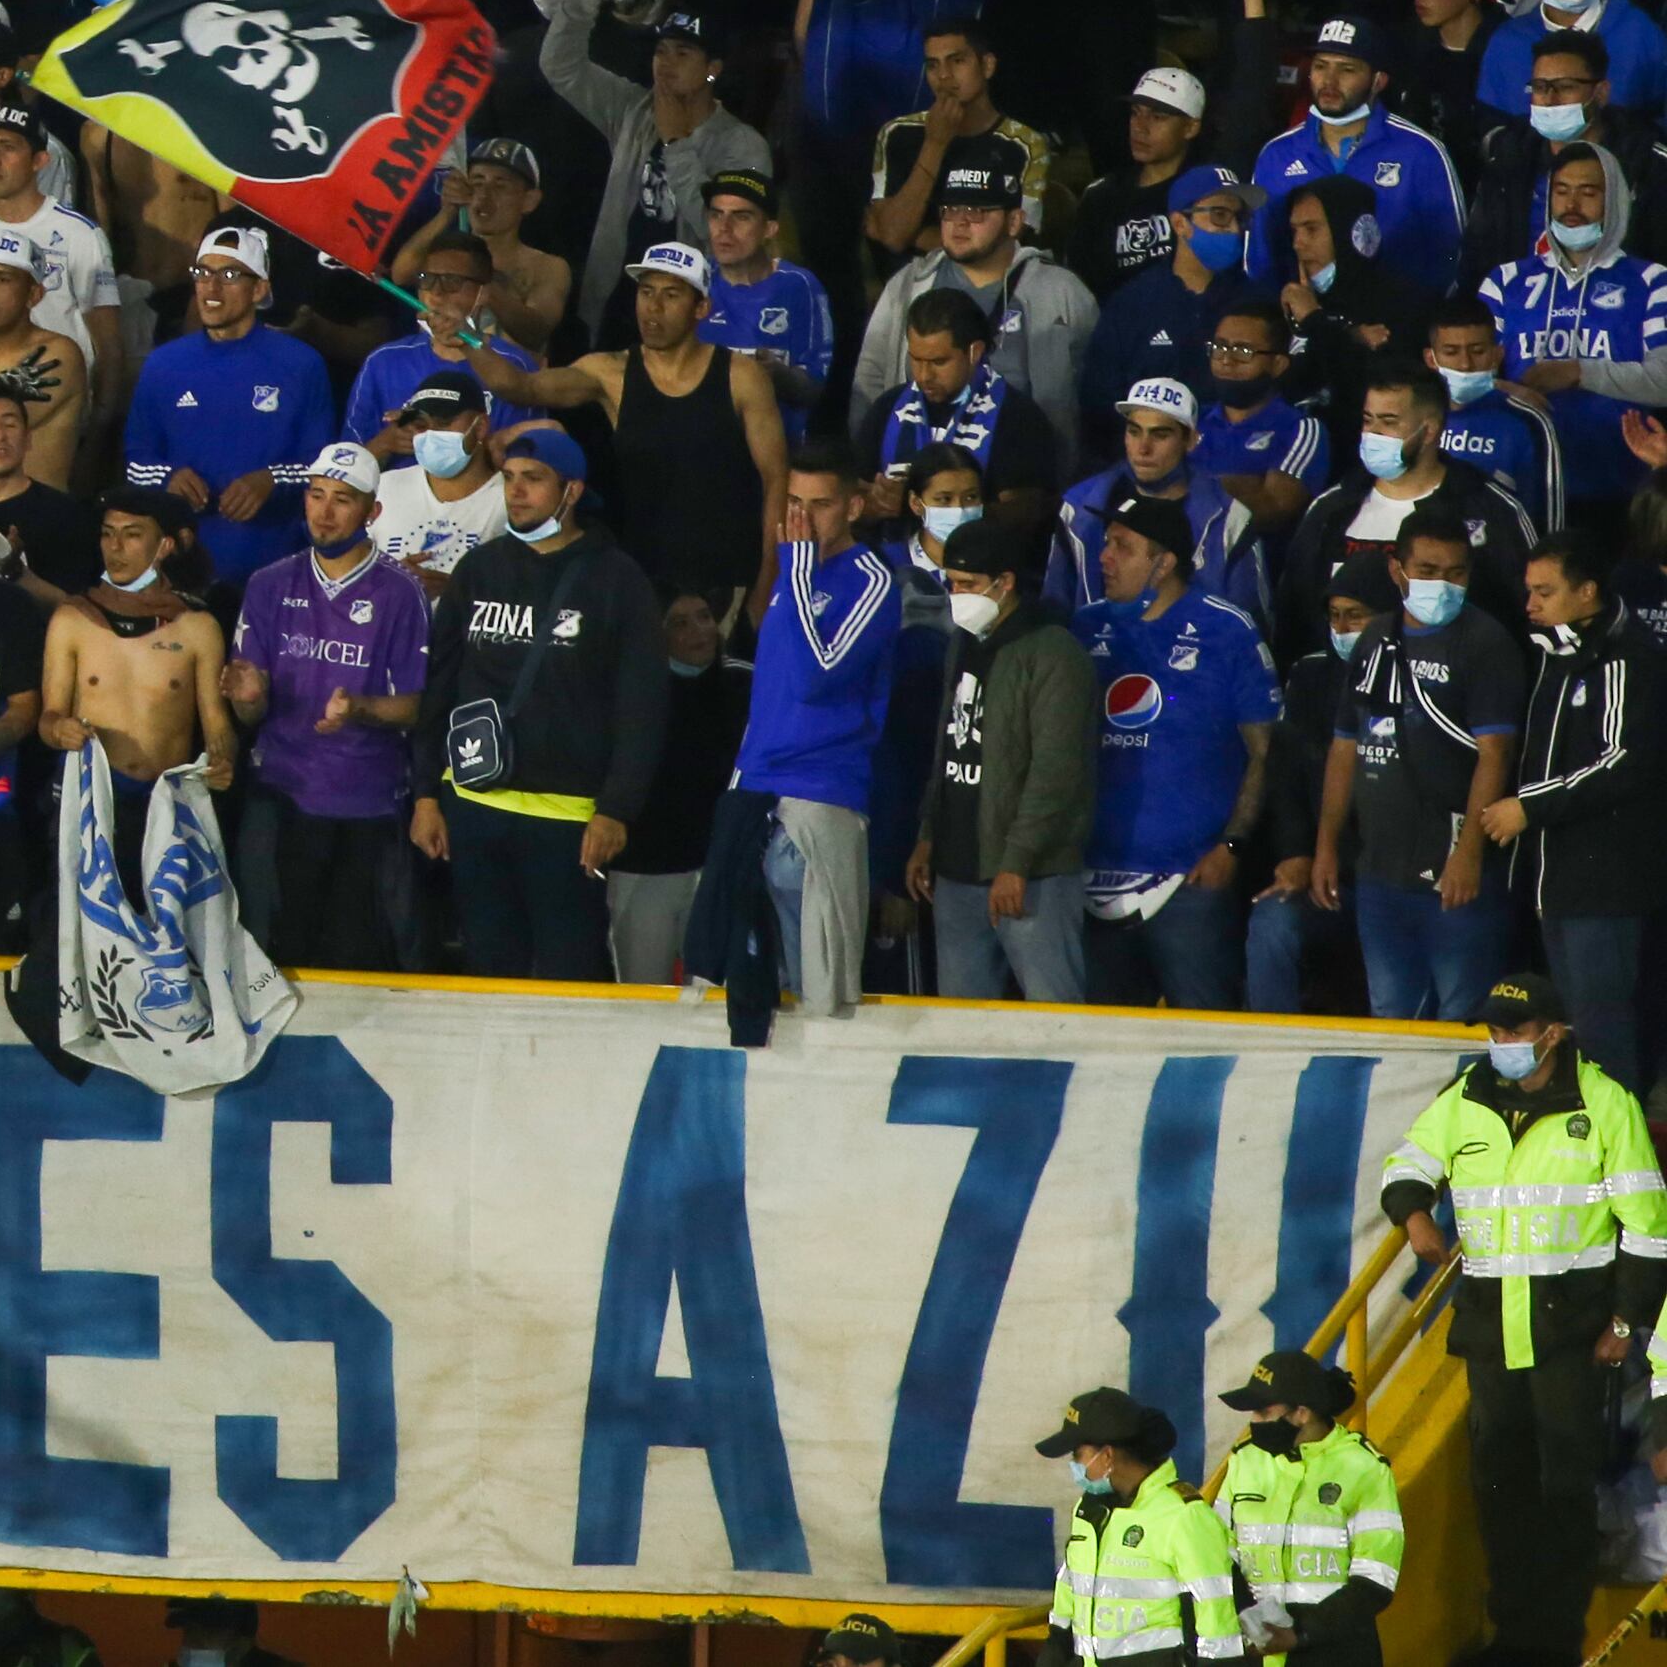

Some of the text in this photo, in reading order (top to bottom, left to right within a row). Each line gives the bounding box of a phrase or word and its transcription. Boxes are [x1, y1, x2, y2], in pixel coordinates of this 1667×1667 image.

[1524, 276, 1545, 308] 7
[1519, 329, 1613, 362] LEONA
[468, 599, 536, 637] ZONA
[1102, 733, 1149, 748] pepsi
[572, 1045, 1485, 1588] AZU
